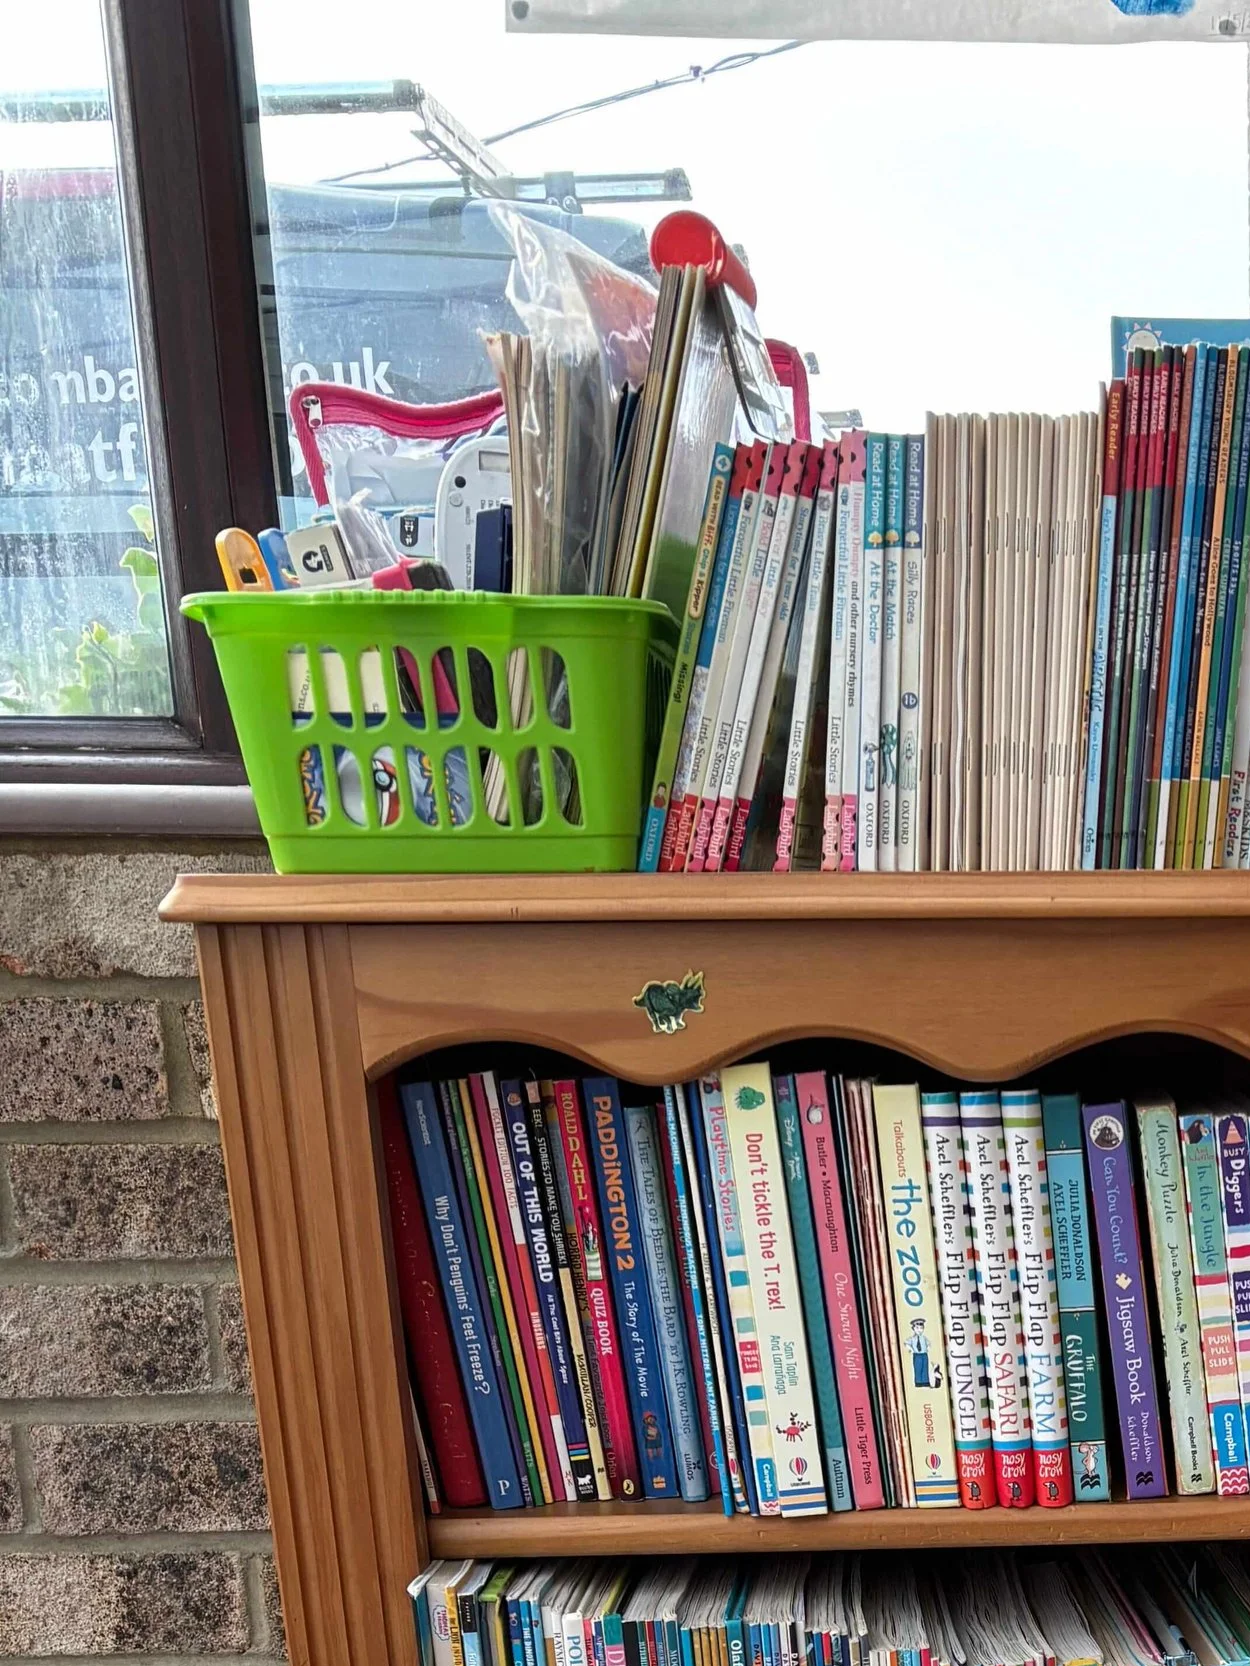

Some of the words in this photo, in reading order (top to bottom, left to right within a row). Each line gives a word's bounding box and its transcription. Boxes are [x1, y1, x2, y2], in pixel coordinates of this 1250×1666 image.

[908, 442, 921, 474] Read
[910, 475, 919, 489] at
[907, 492, 919, 527] Home
[905, 589, 916, 626] Races
[779, 799, 794, 860] Ladybird
[900, 799, 910, 846] OXFORD
[512, 1120, 532, 1153] OUT
[745, 1132, 770, 1178] Don't
[893, 1119, 907, 1178] Talkabouts
[518, 1156, 536, 1177] OF
[434, 1195, 453, 1224] Why
[523, 1178, 546, 1224] THIS
[752, 1181, 773, 1228] tickle
[891, 1179, 923, 1238] the
[1053, 1182, 1065, 1211] AXEL
[1068, 1179, 1080, 1210] JULIA
[443, 1225, 462, 1260] Don't
[531, 1227, 553, 1283] WORLD
[617, 1255, 635, 1271] 2
[760, 1229, 778, 1257] the
[1056, 1214, 1073, 1281] SCHEFFLER
[1069, 1211, 1088, 1282] DONALDSON
[448, 1260, 471, 1311] Penguins'
[764, 1257, 781, 1275] T.
[895, 1246, 924, 1308] zoo
[944, 1251, 964, 1295] Flip
[769, 1278, 786, 1311] rex!
[461, 1315, 477, 1342] Feet
[948, 1298, 970, 1347] Flap
[466, 1342, 491, 1395] Freeze?
[1065, 1333, 1088, 1423] GRUFFALO
[949, 1349, 979, 1439] JUNGLE
[992, 1351, 1020, 1437] SAFARI
[1030, 1353, 1057, 1436] FARM
[1223, 1412, 1238, 1463] Campbell
